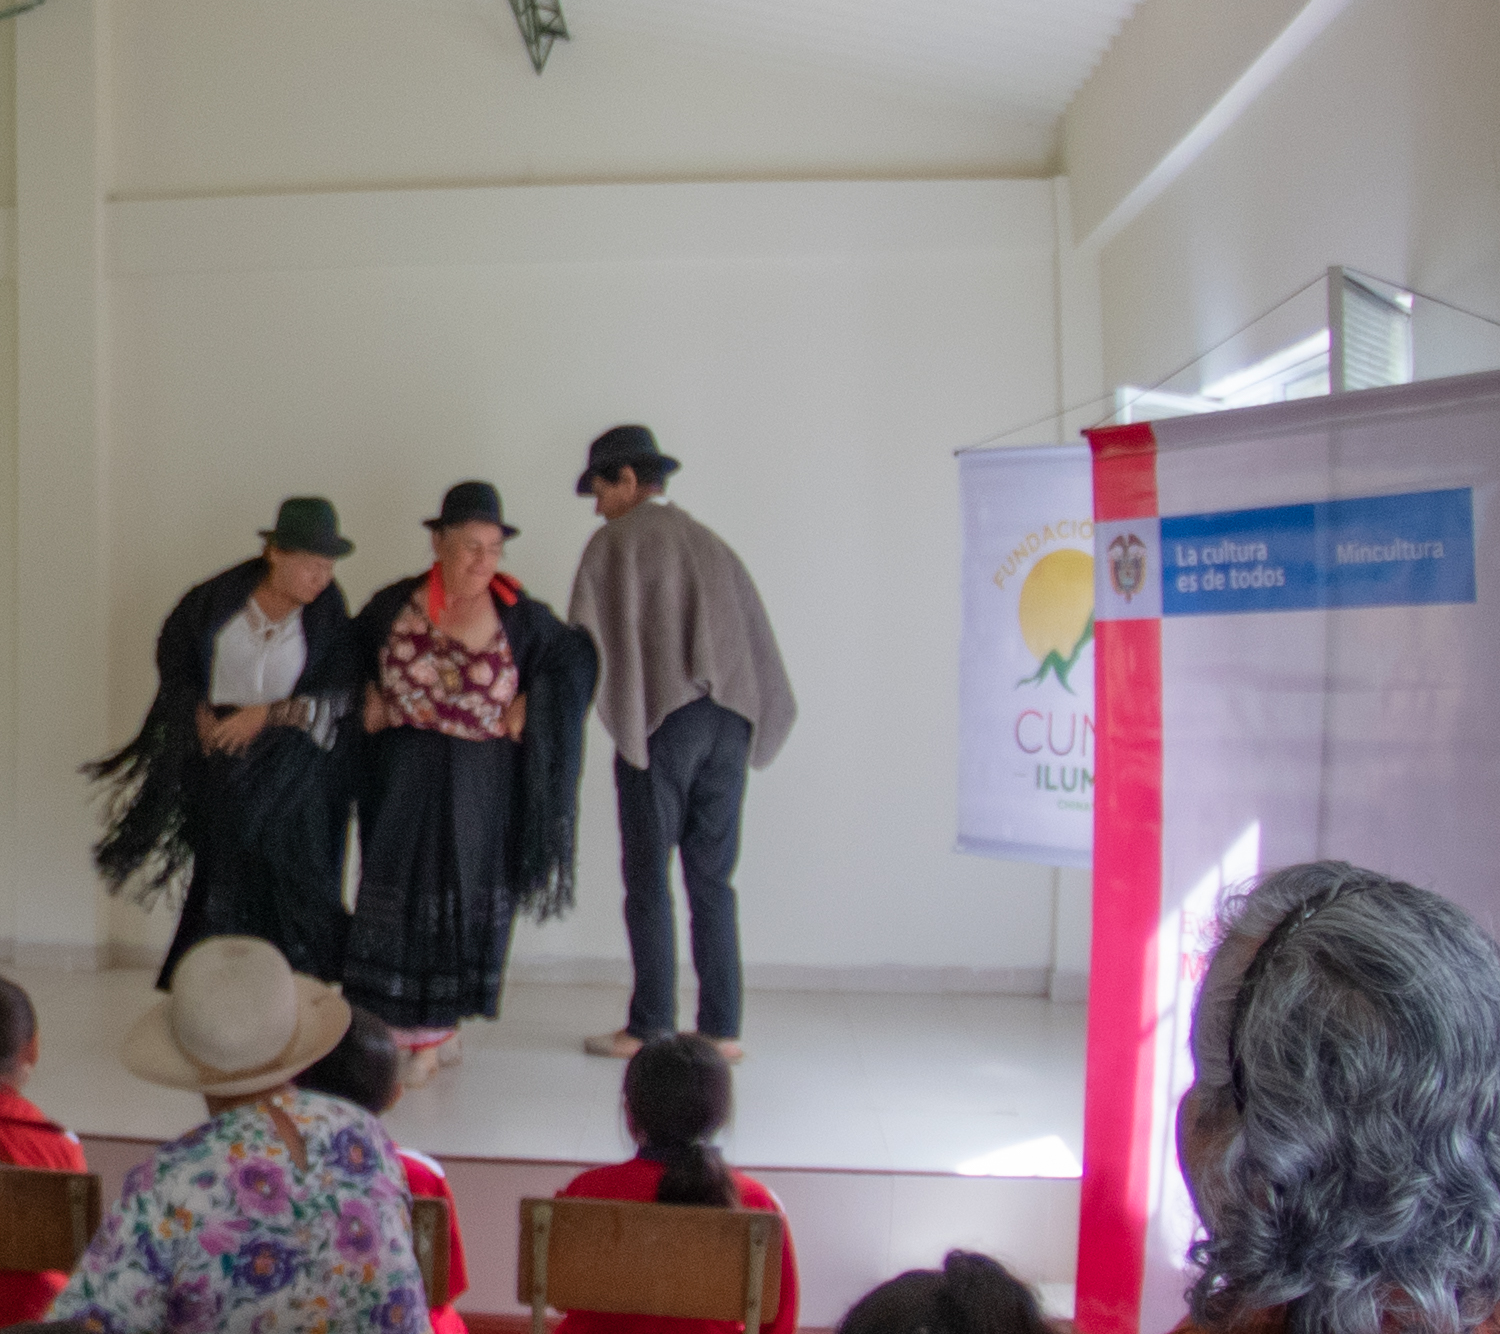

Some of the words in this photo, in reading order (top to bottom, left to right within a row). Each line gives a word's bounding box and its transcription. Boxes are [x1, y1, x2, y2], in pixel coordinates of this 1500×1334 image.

[993, 516, 1095, 590] FUNDACIÓ
[1175, 544, 1198, 567] La
[1201, 538, 1268, 566] cultura
[1336, 537, 1445, 565] Mincultura
[1176, 572, 1198, 593] es
[1202, 568, 1226, 591] de
[1229, 565, 1286, 590] todos
[1035, 764, 1096, 794] ILUM
